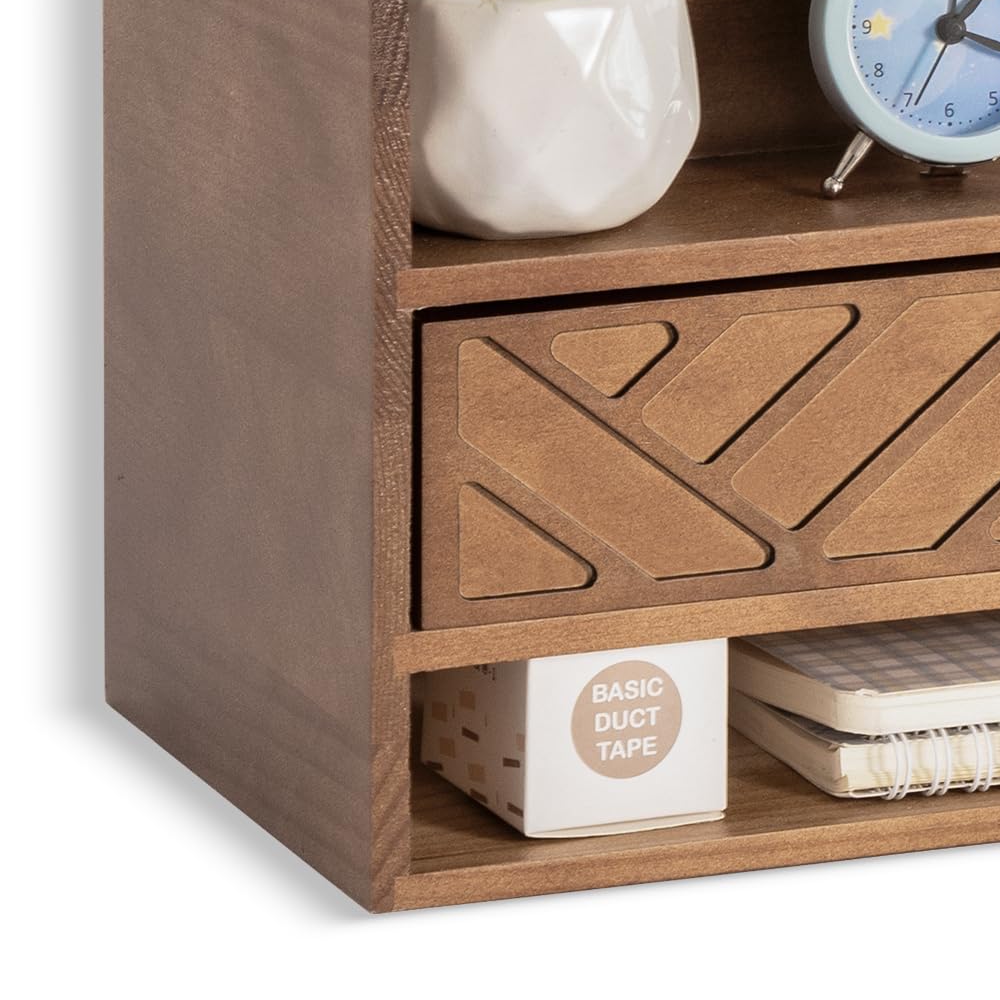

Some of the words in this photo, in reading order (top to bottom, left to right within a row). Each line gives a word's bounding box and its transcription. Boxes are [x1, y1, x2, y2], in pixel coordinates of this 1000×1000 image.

[861, 18, 872, 35] 9
[873, 62, 885, 78] 8
[903, 92, 914, 107] 7
[988, 90, 999, 107] 5
[943, 102, 955, 118] 6
[591, 676, 665, 704] BASIC
[593, 705, 663, 733] DUCT
[595, 736, 658, 762] TAPE
